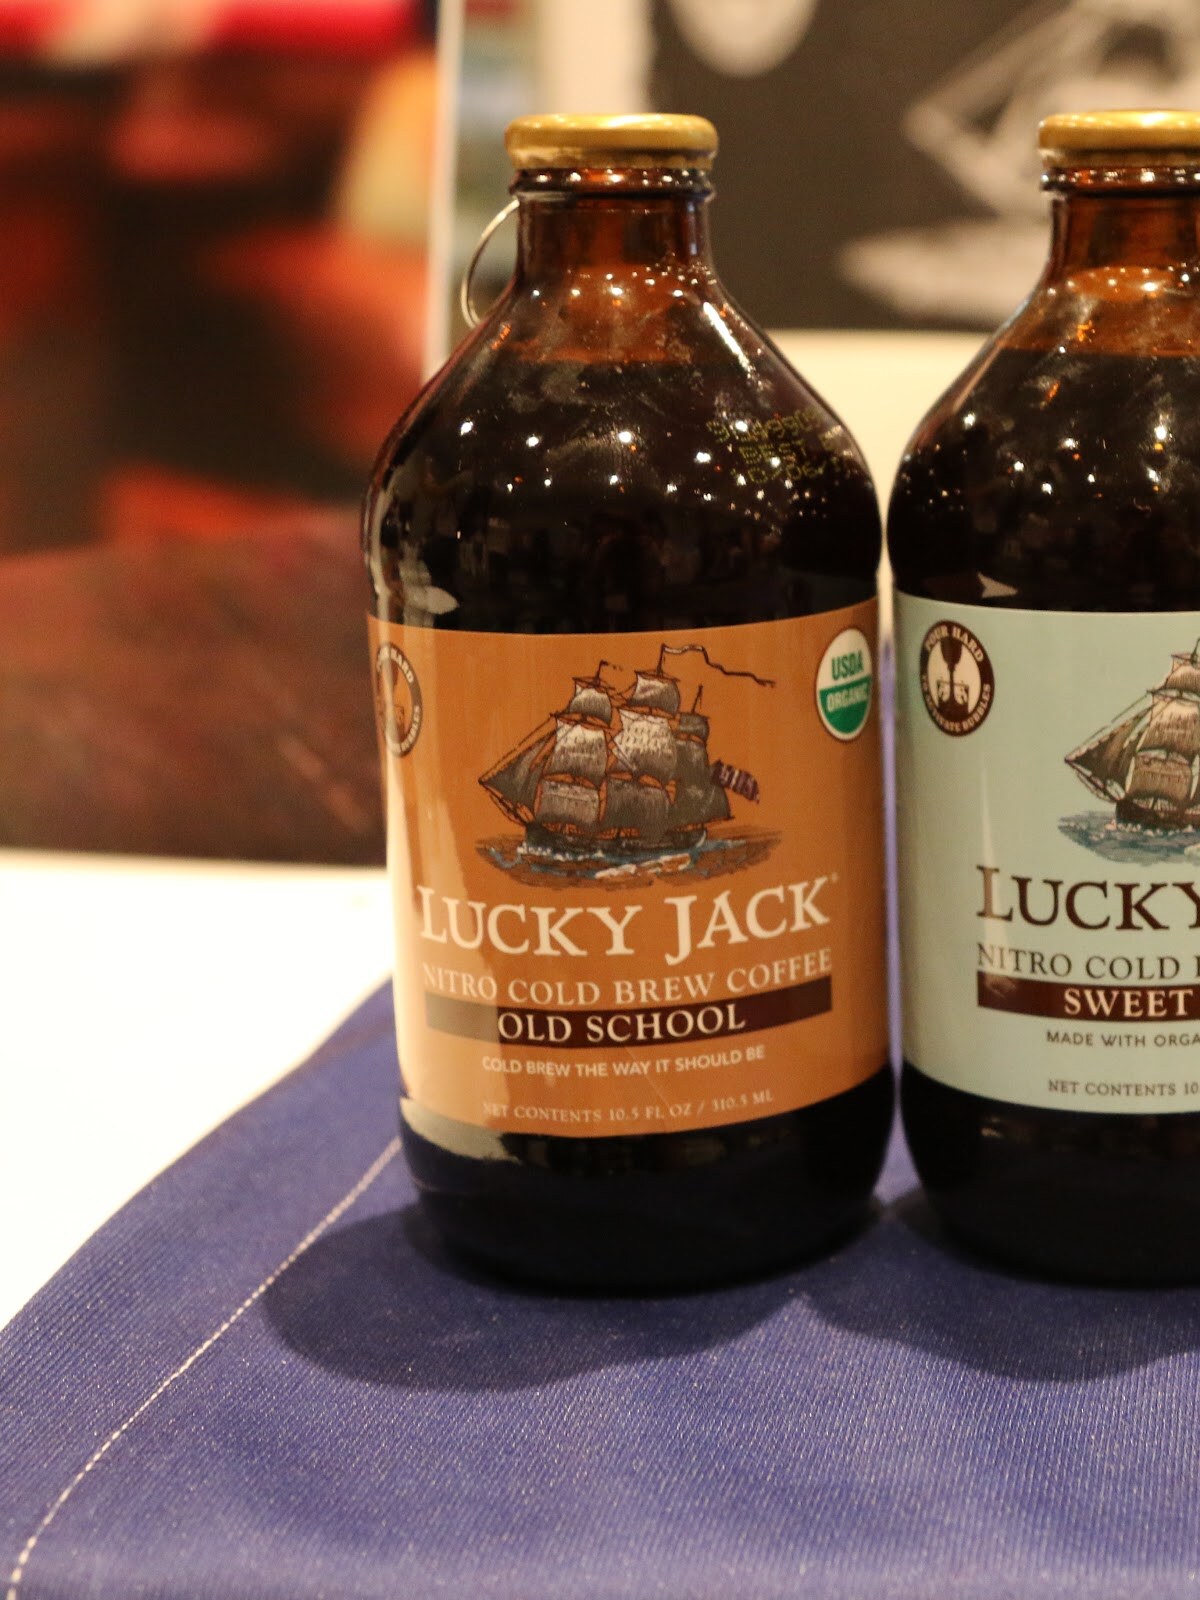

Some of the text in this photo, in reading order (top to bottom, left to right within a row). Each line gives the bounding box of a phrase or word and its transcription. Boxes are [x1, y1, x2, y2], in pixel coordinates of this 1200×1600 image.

[952, 625, 984, 662] HARD
[831, 650, 864, 681] USDA
[416, 876, 831, 966] LUCKY JACK
[422, 947, 832, 1006] NITRO COLD BREW COFFEE
[976, 943, 1073, 978] NITRO
[1085, 955, 1180, 981] COLD
[1063, 985, 1193, 1019] SWEET
[498, 1003, 746, 1044] OLD SCHOOL
[1046, 1030, 1095, 1047] MADE
[1100, 1034, 1147, 1048] WITH
[482, 1044, 765, 1077] COLD BREW THE WAY IT SHOULD BE
[1047, 1079, 1080, 1095] NET
[1084, 1080, 1177, 1097] CONTENTS
[483, 1102, 509, 1117] NET
[513, 1105, 602, 1122] CONTENTS
[609, 1107, 639, 1121] 10.5
[645, 1106, 665, 1120] FL
[669, 1103, 692, 1117] OZ
[711, 1094, 747, 1112] 310.5
[752, 1089, 774, 1104] ML
